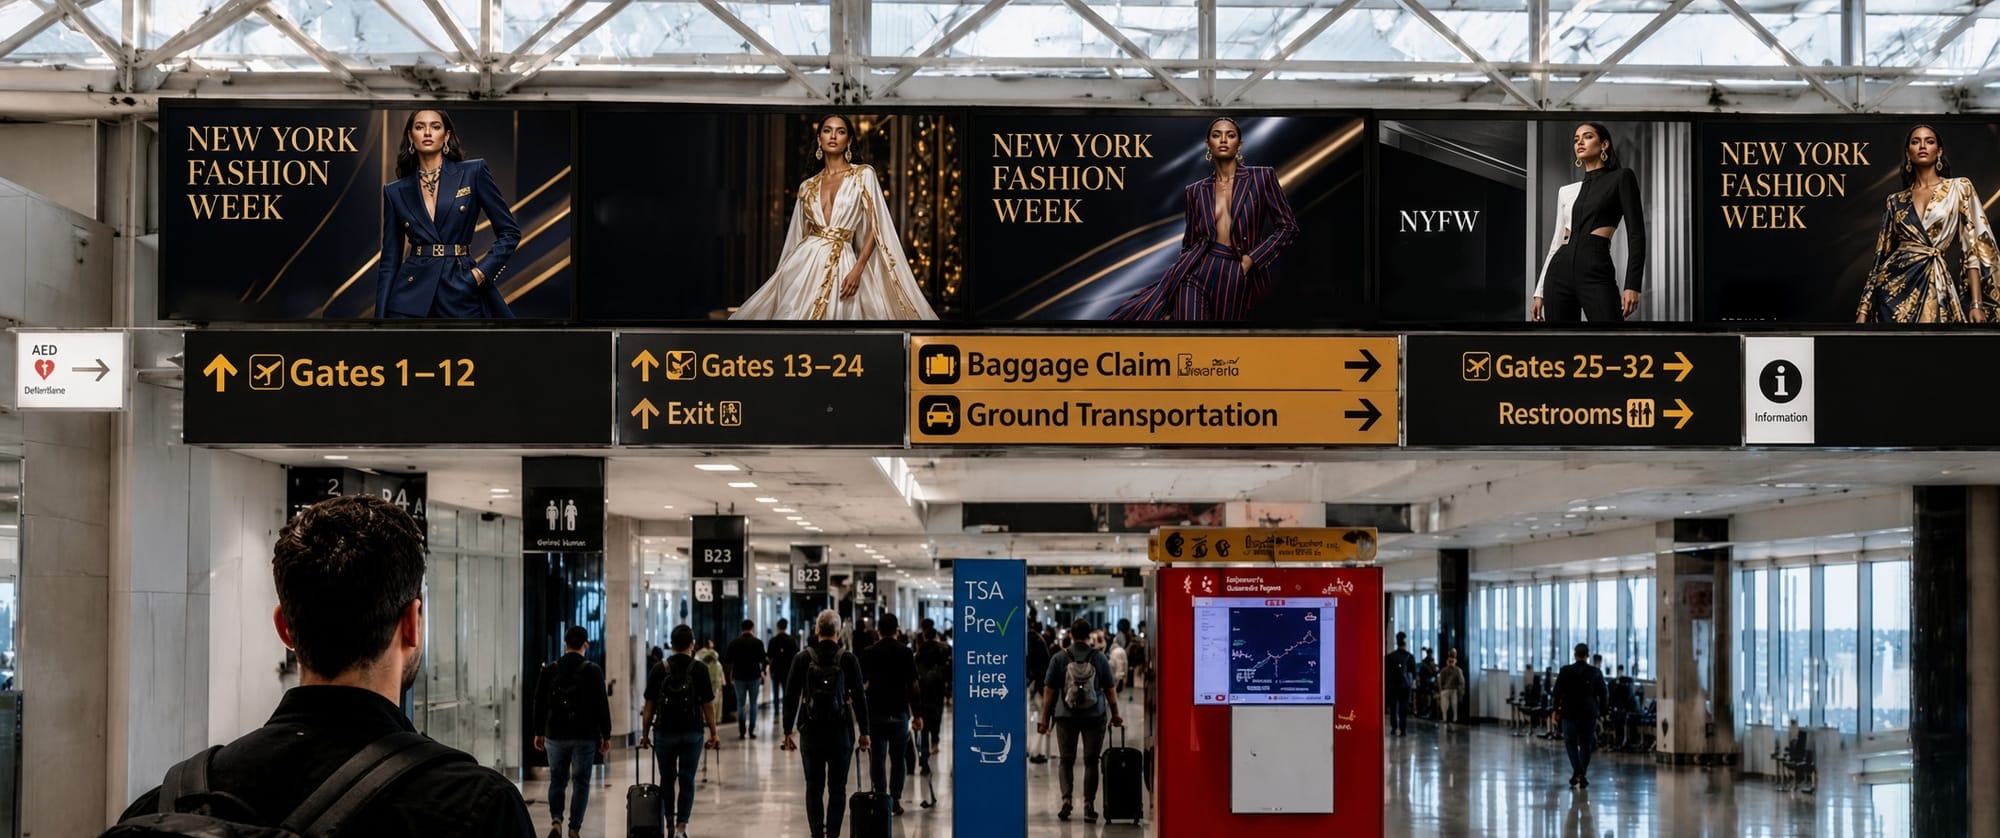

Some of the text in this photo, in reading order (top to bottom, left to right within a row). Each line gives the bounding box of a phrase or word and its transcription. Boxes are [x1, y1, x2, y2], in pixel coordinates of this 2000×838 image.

[187, 126, 358, 152] NEW YORK
[992, 133, 1153, 159] NEW YORK
[1721, 141, 1871, 166] NEW YORK
[187, 159, 330, 186] FASHION
[993, 165, 1126, 191] FASHION
[1721, 173, 1846, 198] FASHION
[187, 193, 284, 220] WEEK
[992, 198, 1084, 224] WEEK
[1721, 205, 1807, 229] WEEK
[1399, 210, 1480, 233] NYFW
[32, 344, 58, 356] AED
[290, 358, 385, 387] Gates
[701, 353, 775, 378] Gates
[968, 351, 1089, 383] Baggage
[1095, 351, 1171, 377] Claim
[1495, 354, 1566, 379] Gates
[668, 400, 715, 425] Exit
[966, 400, 1278, 434] Ground Transportation
[1499, 401, 1623, 425] Restrooms
[1755, 411, 1808, 423] Information
[704, 549, 732, 563] B23
[798, 569, 821, 582] B23
[964, 580, 1004, 600] TSA
[967, 650, 1009, 665] Enter
